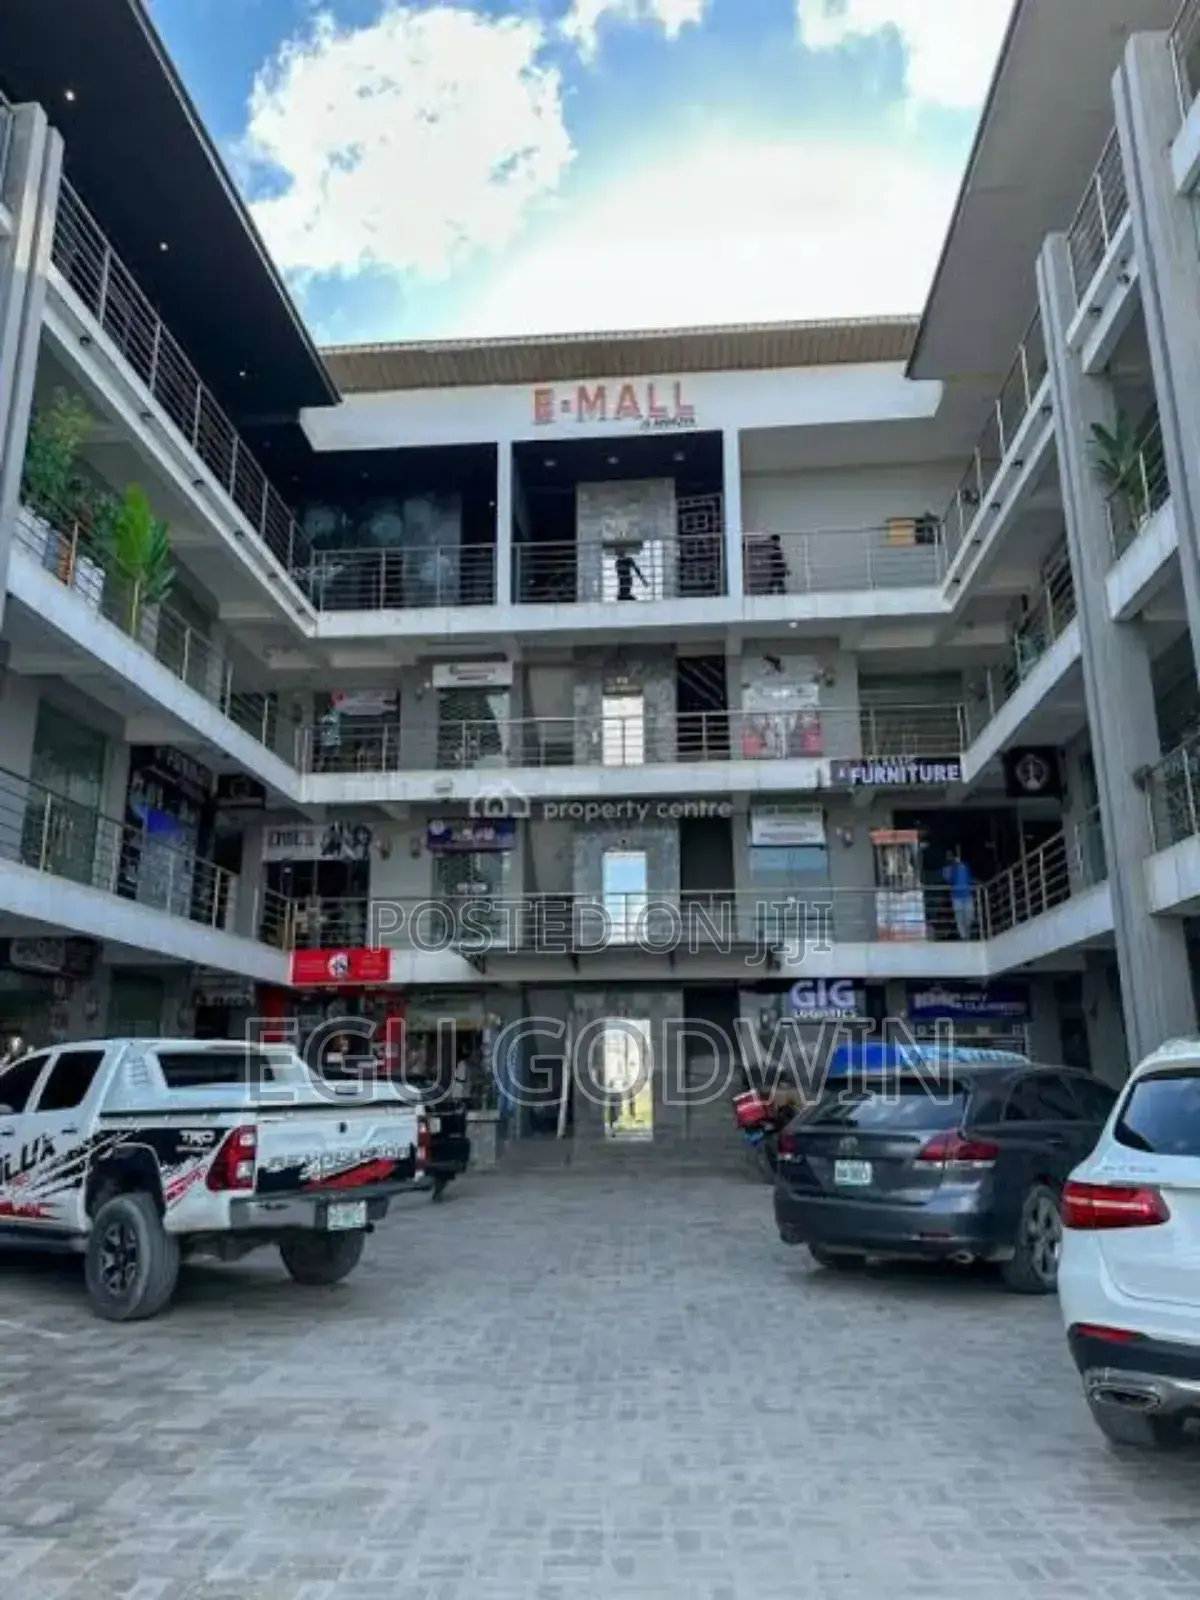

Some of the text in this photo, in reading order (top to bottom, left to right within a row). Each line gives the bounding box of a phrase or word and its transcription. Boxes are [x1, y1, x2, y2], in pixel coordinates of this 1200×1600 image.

[533, 381, 695, 424] E-MALL
[851, 763, 961, 784] FURNITURE
[790, 979, 857, 1007] GIG
